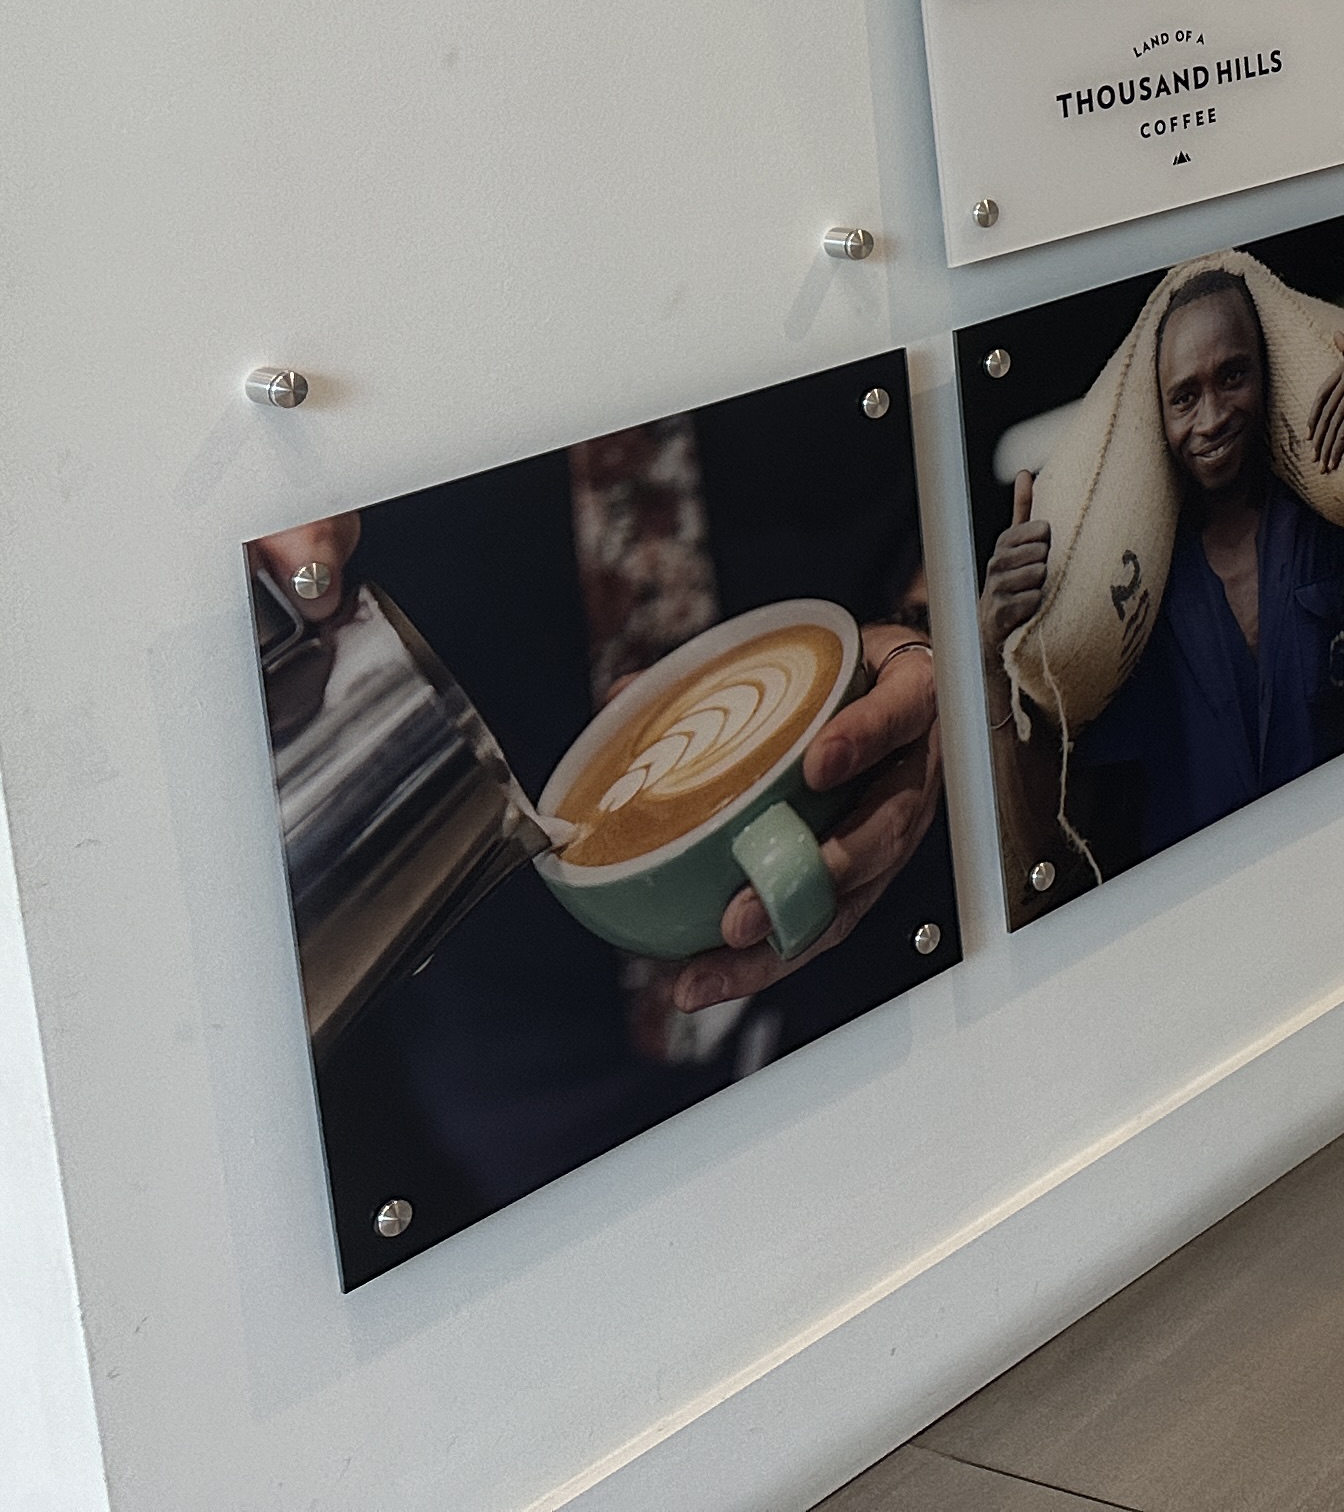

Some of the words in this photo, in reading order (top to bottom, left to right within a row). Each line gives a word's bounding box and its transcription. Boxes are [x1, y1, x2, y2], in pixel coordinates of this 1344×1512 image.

[1133, 32, 1170, 58] LAND
[1175, 30, 1193, 44] OF
[1196, 33, 1205, 45] A
[1056, 67, 1210, 120] THOUSAND
[1216, 50, 1284, 86] HILLS
[1140, 107, 1218, 139] COFFEE
